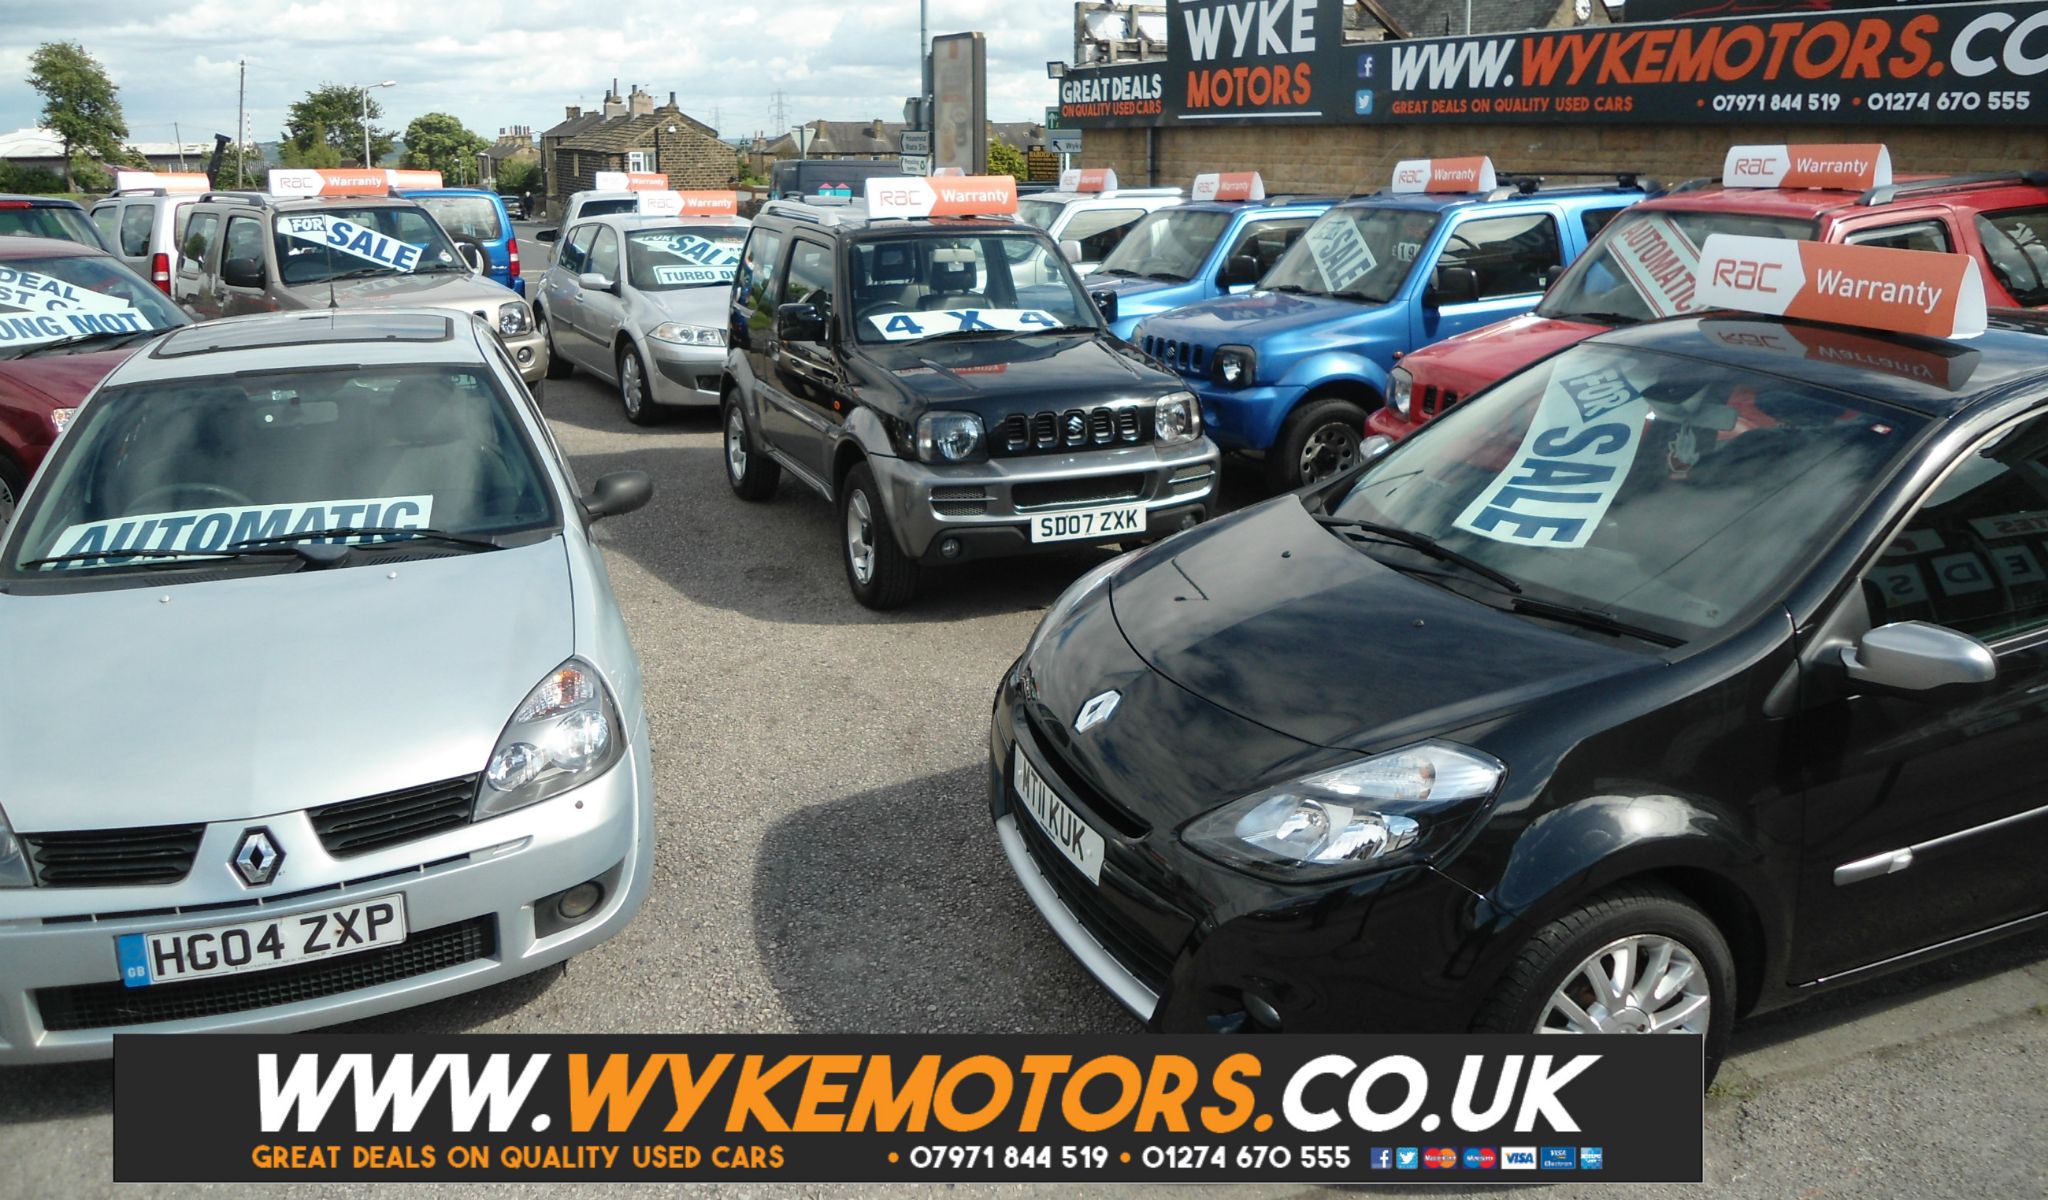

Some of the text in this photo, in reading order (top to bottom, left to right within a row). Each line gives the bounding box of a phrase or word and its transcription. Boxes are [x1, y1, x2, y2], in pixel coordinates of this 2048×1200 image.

[1183, 0, 1318, 61] WYKE
[1062, 73, 1162, 103] GREAT DEALS
[1186, 62, 1312, 108] MOTORS
[1062, 99, 1162, 118] ON QUALITY USED CARS
[1392, 96, 1633, 114] GREAT DEALS ON QUALITY USED CARS
[1712, 91, 2031, 112] 07971 844 519 01274 670 555
[1065, 142, 1082, 151] Wyk
[1434, 167, 1477, 182] Warranty
[1734, 157, 1868, 176] RAC Warranty
[328, 176, 383, 187] Warranty
[687, 197, 733, 208] Warranty
[880, 189, 1009, 207] RAC Warranty
[290, 217, 418, 270] FOR SALE
[1318, 228, 1371, 291] SALE
[1620, 219, 1697, 312] AUTOMATIC
[663, 270, 716, 282] TURBO
[1712, 258, 1943, 314] RAC Warranty
[66, 312, 141, 334] MOT
[884, 310, 1057, 335] 4 X 4
[1470, 366, 1633, 543] FOR SALE
[56, 500, 421, 568] AUTOMATIC
[1040, 508, 1138, 537] SD07 ZXK
[152, 923, 285, 976] HG04
[299, 903, 394, 955] ZXP
[127, 965, 146, 978] GB
